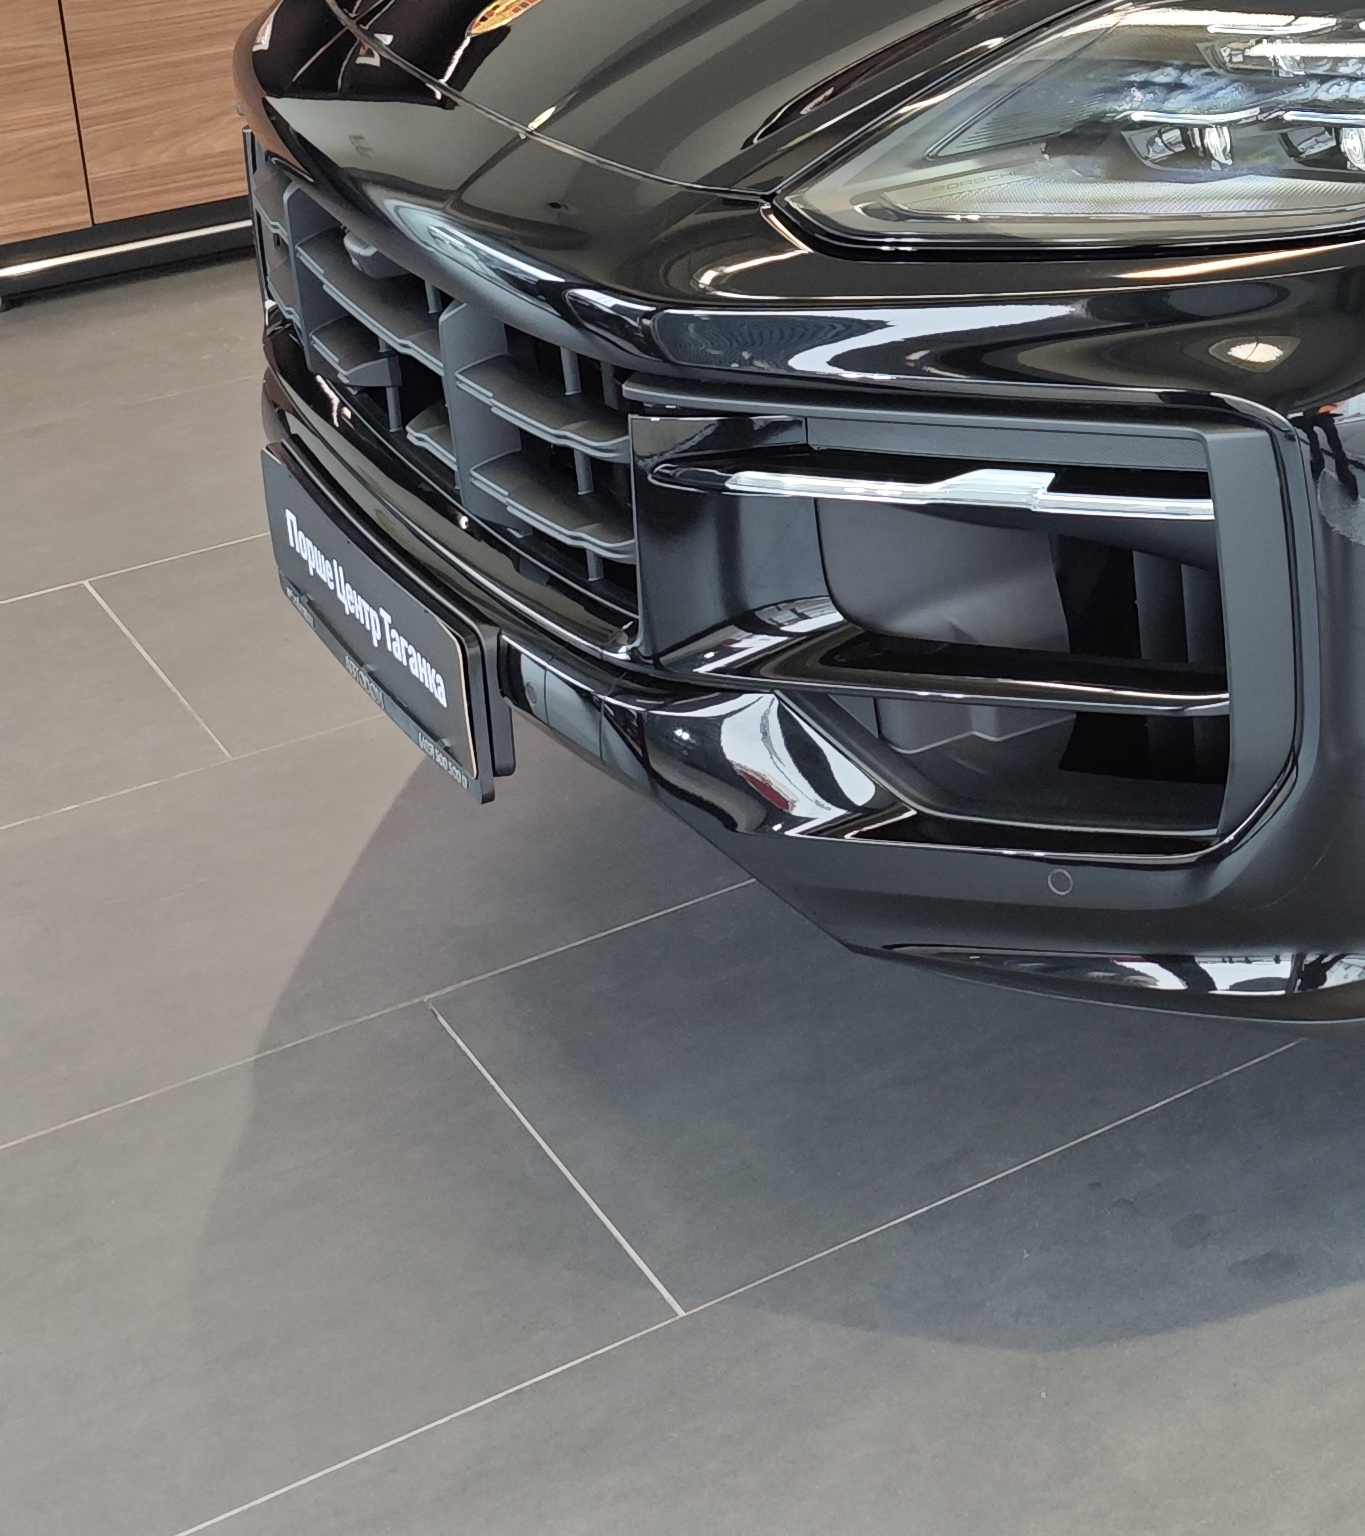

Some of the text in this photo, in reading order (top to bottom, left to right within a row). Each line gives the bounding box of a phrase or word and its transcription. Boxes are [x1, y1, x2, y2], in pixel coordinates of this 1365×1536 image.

[932, 171, 1025, 192] PORSCHE
[285, 508, 336, 591] Порше
[333, 558, 383, 648] Центр
[378, 606, 449, 709] Таганка
